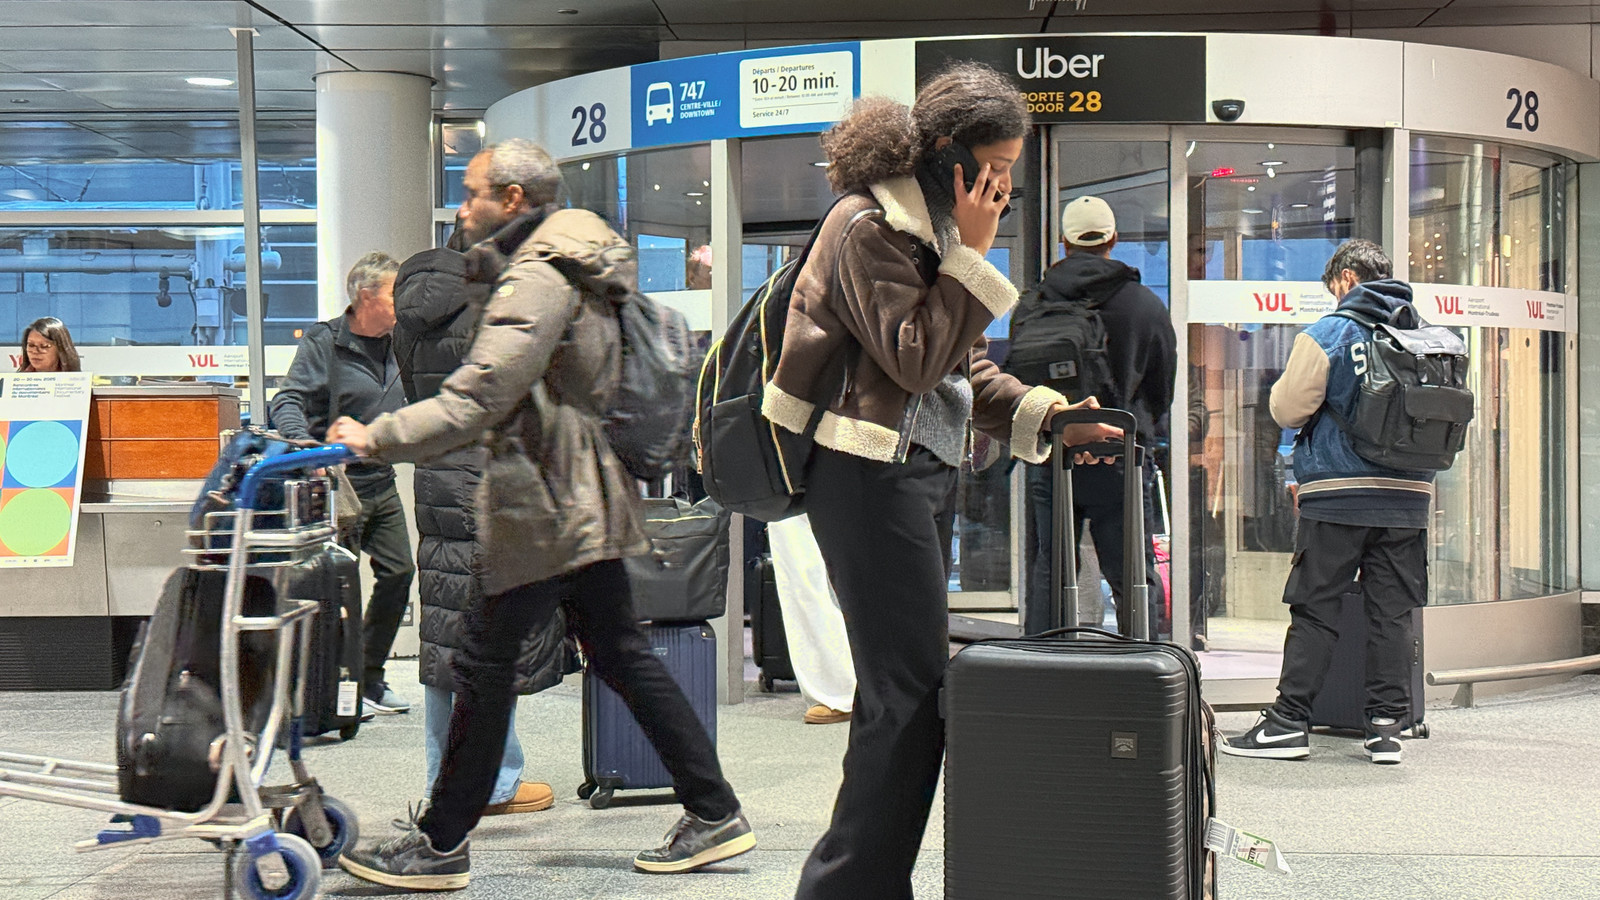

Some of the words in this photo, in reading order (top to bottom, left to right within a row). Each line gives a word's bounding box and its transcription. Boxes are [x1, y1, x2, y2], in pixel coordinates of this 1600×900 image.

[752, 67, 776, 76] Départs
[780, 64, 815, 73] Departures
[1016, 47, 1105, 79] Uber
[680, 80, 706, 102] 747
[1020, 92, 1064, 102] PORTE
[680, 100, 718, 110] CENTRE-VILLE
[1026, 102, 1064, 113] DOOR
[1068, 91, 1102, 112] 28
[1506, 88, 1539, 132] 28
[680, 109, 715, 119] DOWNTOWN
[752, 110, 774, 118] Service
[572, 102, 606, 146] 28
[1253, 292, 1293, 312] YUL
[1434, 296, 1464, 314] YUL
[1526, 300, 1544, 319] YUL
[188, 354, 219, 368] YUL
